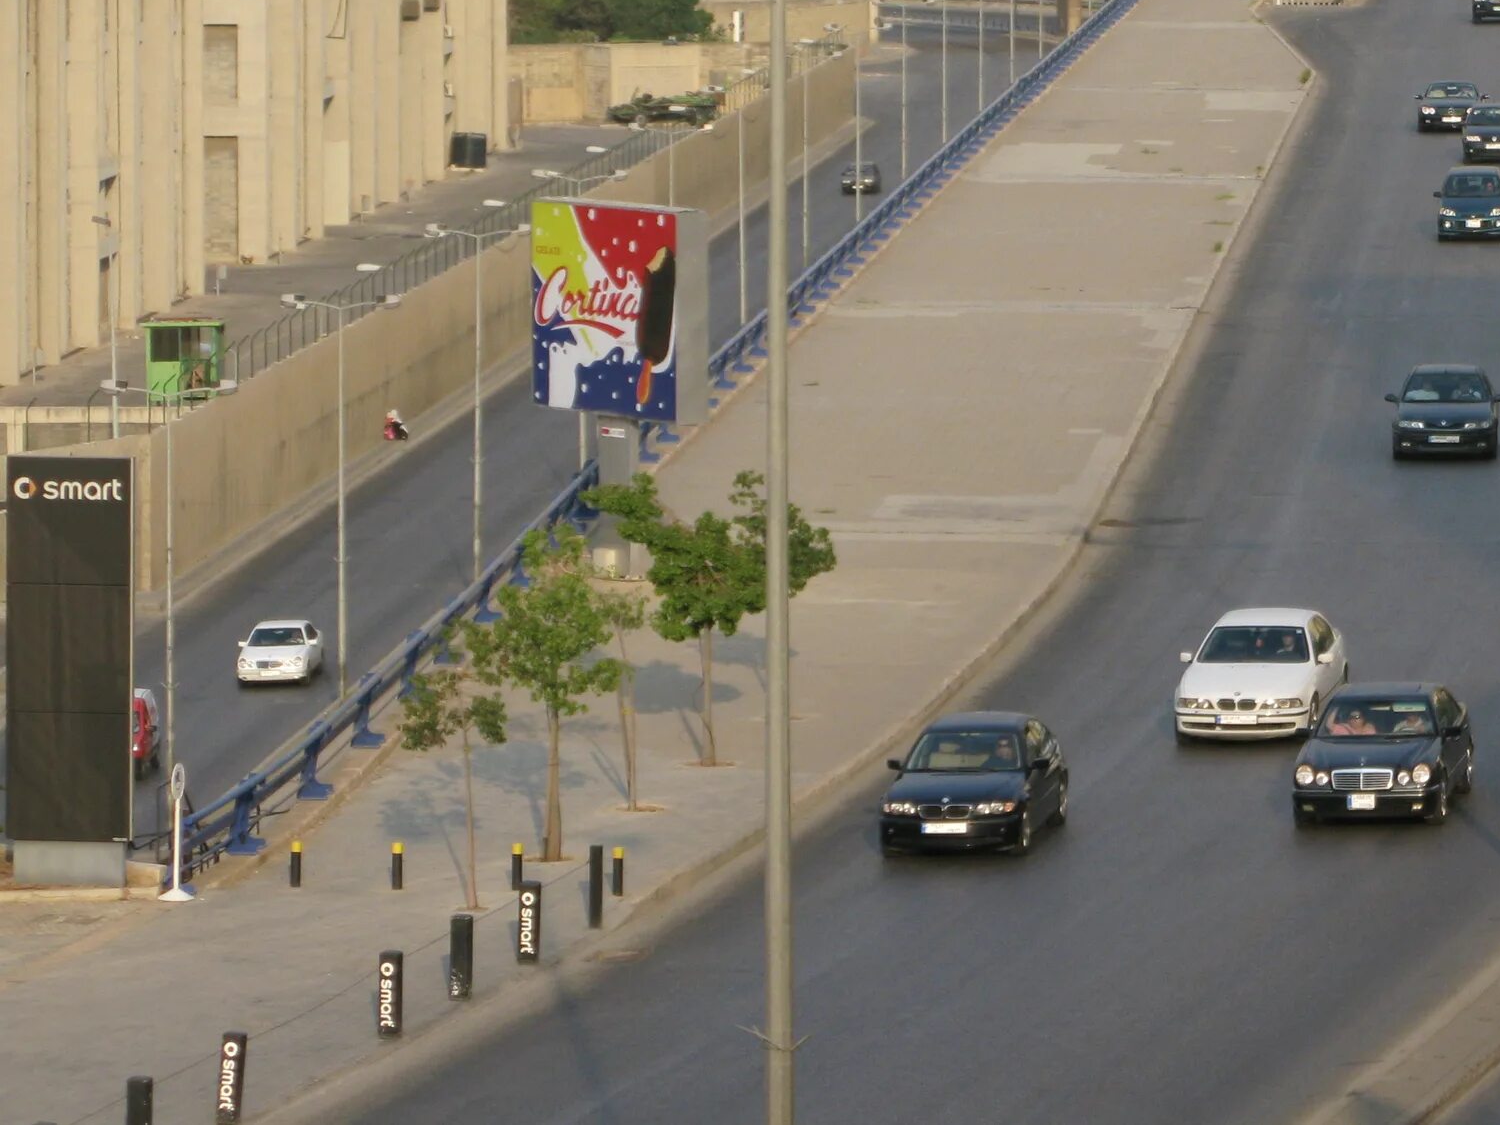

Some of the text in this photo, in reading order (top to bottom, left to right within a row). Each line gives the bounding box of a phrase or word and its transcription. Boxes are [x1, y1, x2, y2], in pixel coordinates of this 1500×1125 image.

[534, 266, 641, 325] Cortina
[42, 478, 122, 501] smart
[520, 907, 534, 954] smart
[380, 978, 395, 1028] smart
[219, 1058, 235, 1110] smart
